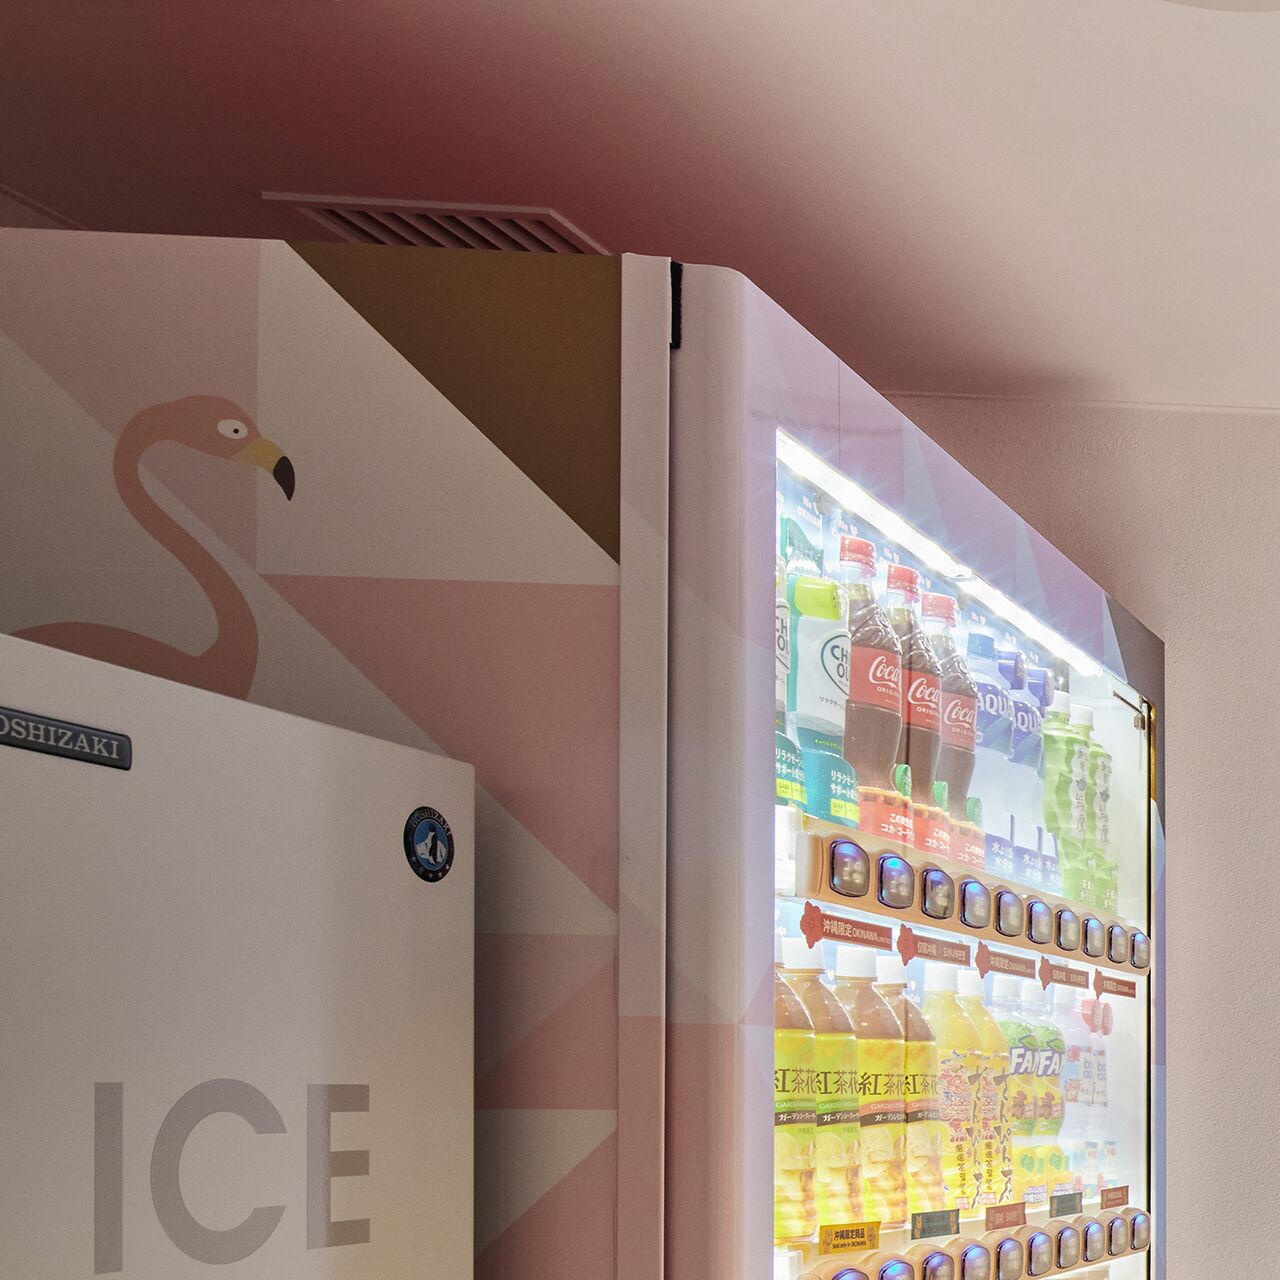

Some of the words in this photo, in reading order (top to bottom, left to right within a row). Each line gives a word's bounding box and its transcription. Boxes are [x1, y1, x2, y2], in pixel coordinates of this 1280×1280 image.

[822, 918, 852, 938] 沖縄限定
[852, 927, 878, 942] OKINAWA
[94, 1078, 371, 1275] ICE
[833, 1227, 866, 1242] 沖縄限定商品
